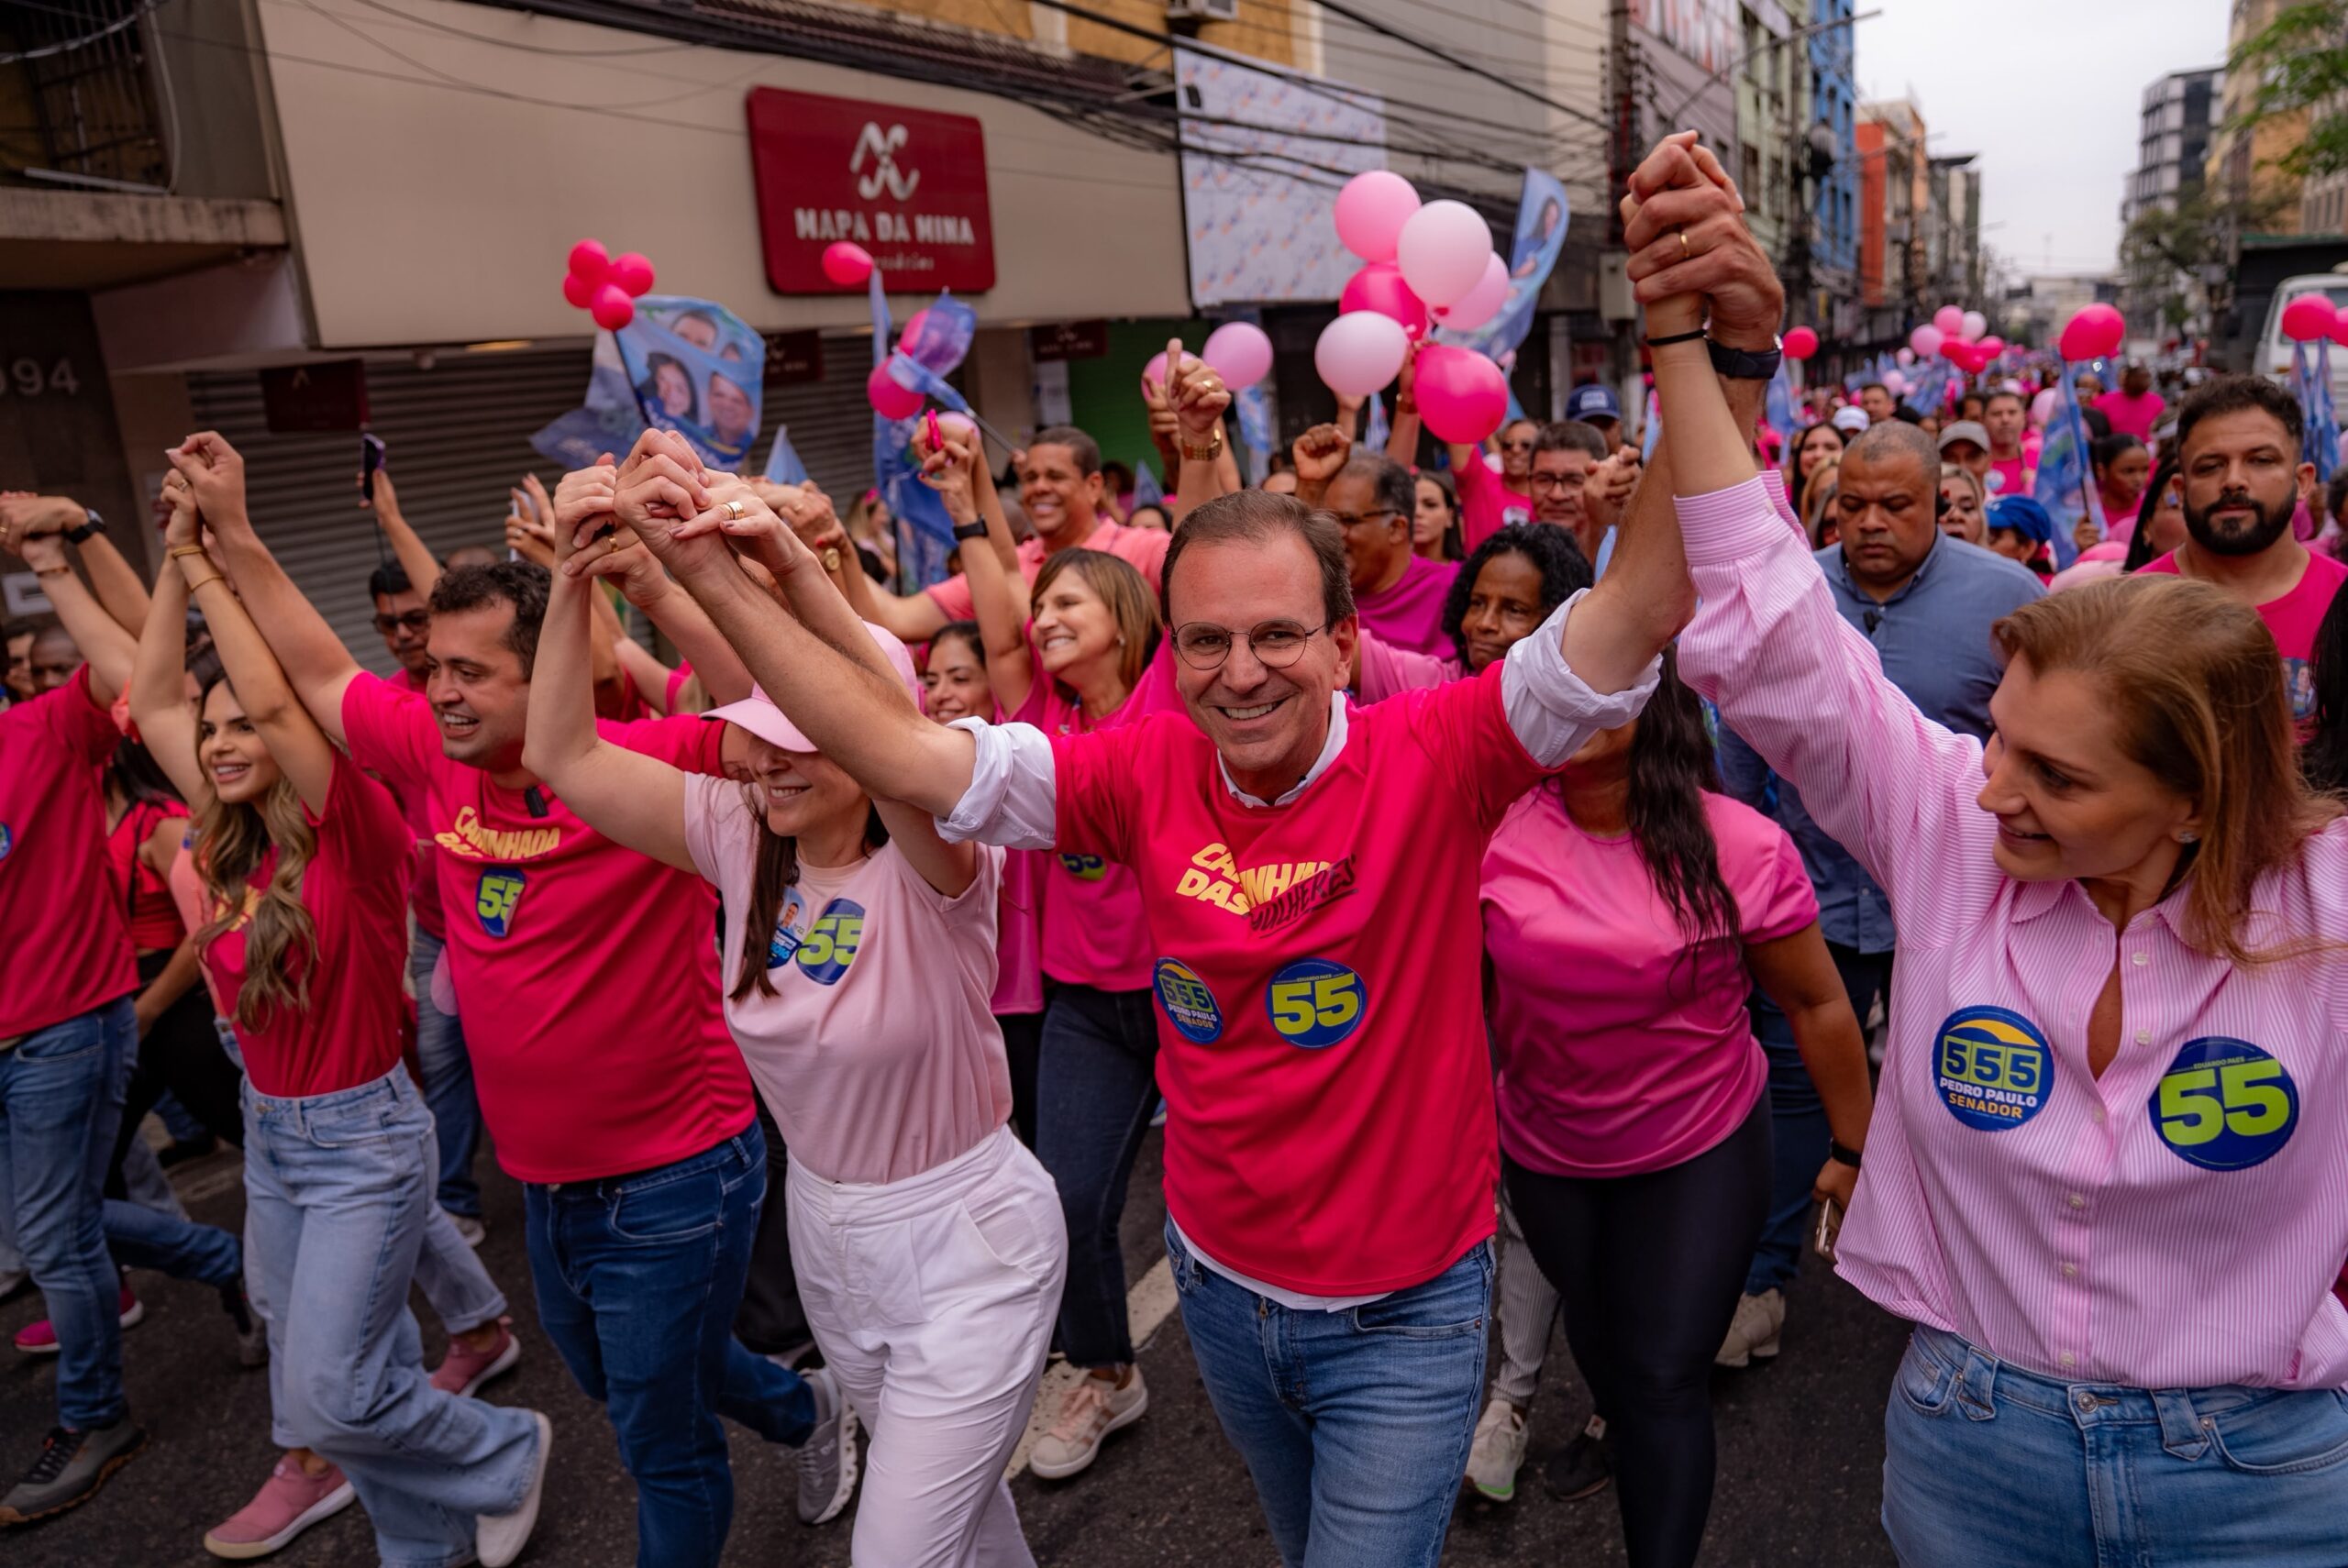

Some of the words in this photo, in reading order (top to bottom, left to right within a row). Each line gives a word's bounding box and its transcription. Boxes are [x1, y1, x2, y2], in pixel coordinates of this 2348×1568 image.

[793, 207, 870, 241] MAPA
[874, 211, 911, 242] DA
[914, 214, 976, 245] MINA
[0, 356, 81, 397] 94
[1175, 867, 1251, 916] DAS
[797, 918, 864, 966] 55
[1159, 977, 1212, 1010] 555
[1271, 972, 1359, 1035] 55
[1176, 1013, 1215, 1029] SENADOR
[1191, 1009, 1218, 1022] PAULO
[1944, 1039, 2037, 1089] 555
[1939, 1077, 1983, 1099] PEDRO
[1985, 1088, 2038, 1109] PAULO
[1948, 1092, 2022, 1119] SENADOR
[2159, 1058, 2290, 1146] 55
